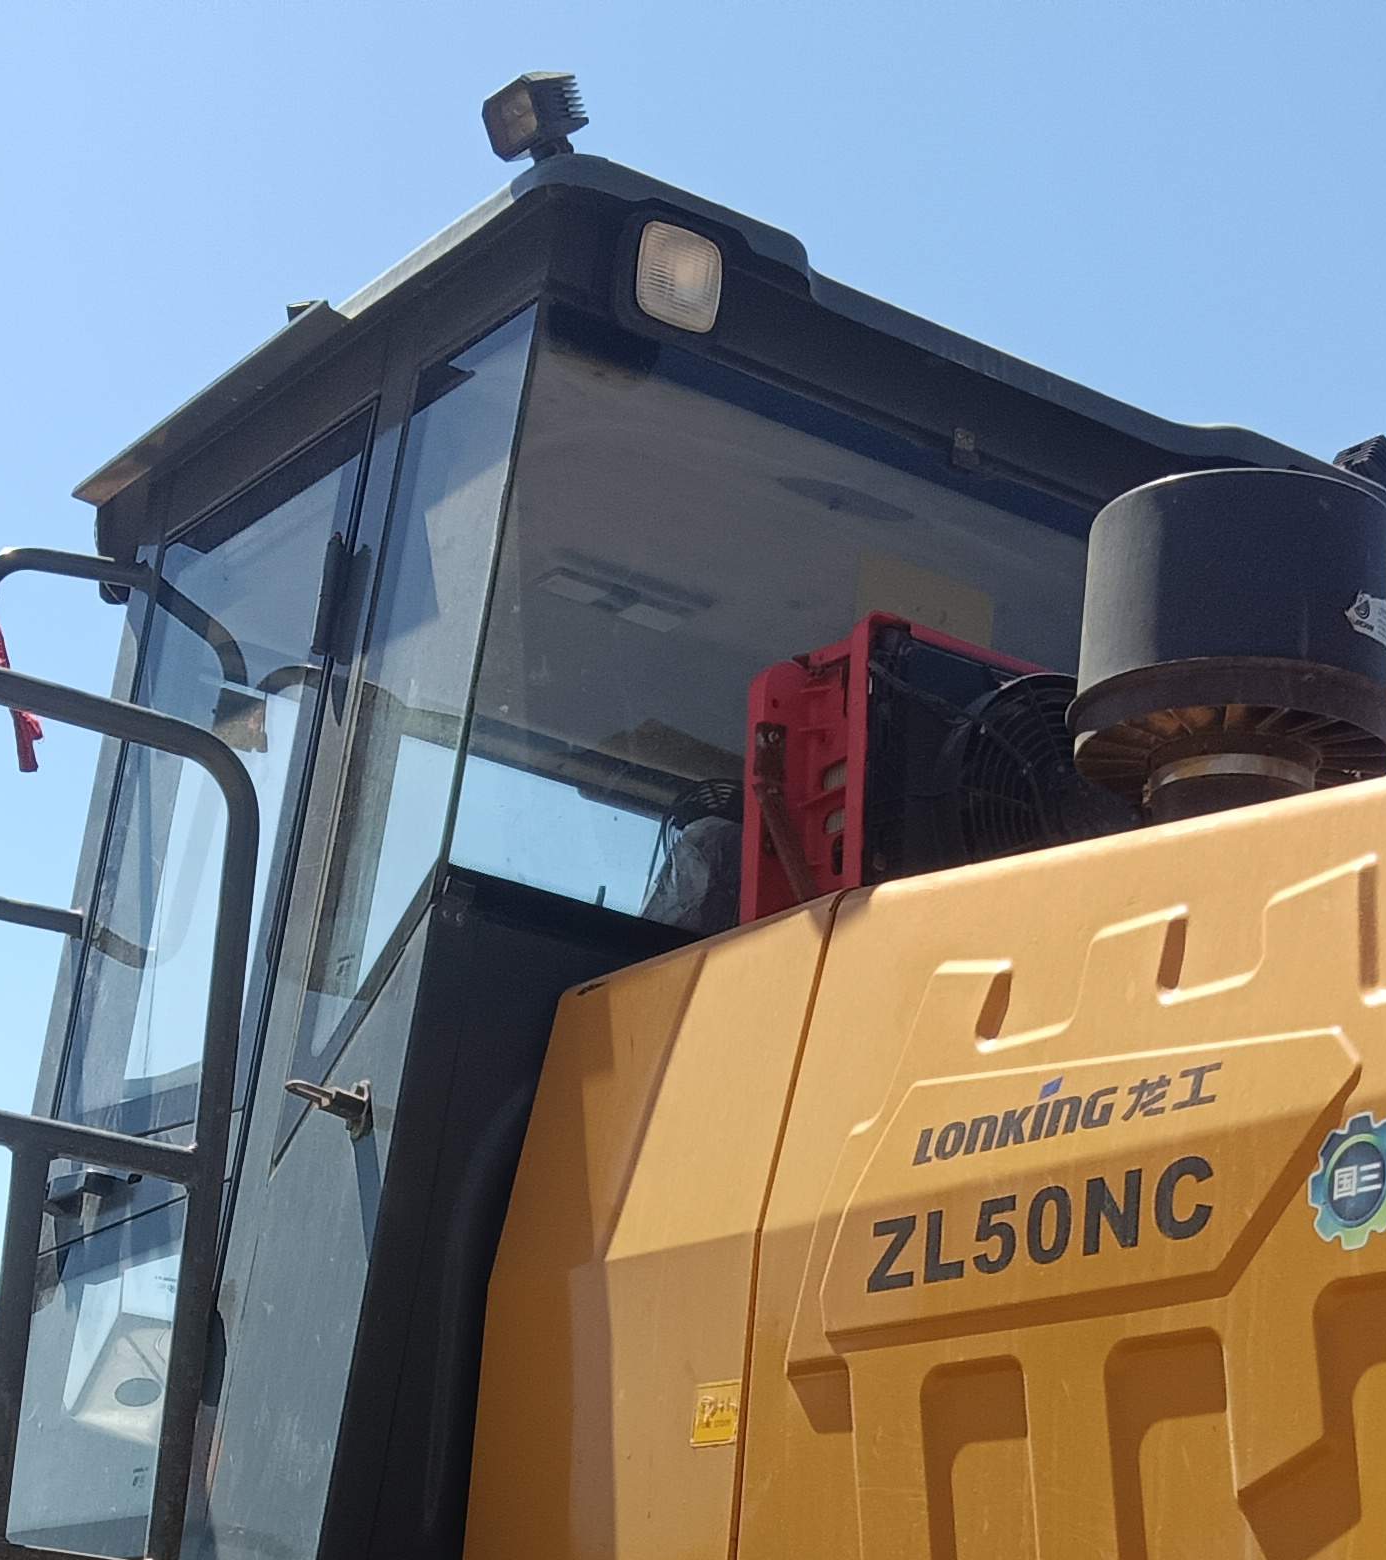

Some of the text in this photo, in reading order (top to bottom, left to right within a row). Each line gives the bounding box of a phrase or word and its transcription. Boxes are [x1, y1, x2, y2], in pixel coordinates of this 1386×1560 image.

[1121, 1061, 1223, 1122] 龙工
[1332, 1161, 1383, 1201] 国三
[866, 1155, 1215, 1294] ZL50NC
